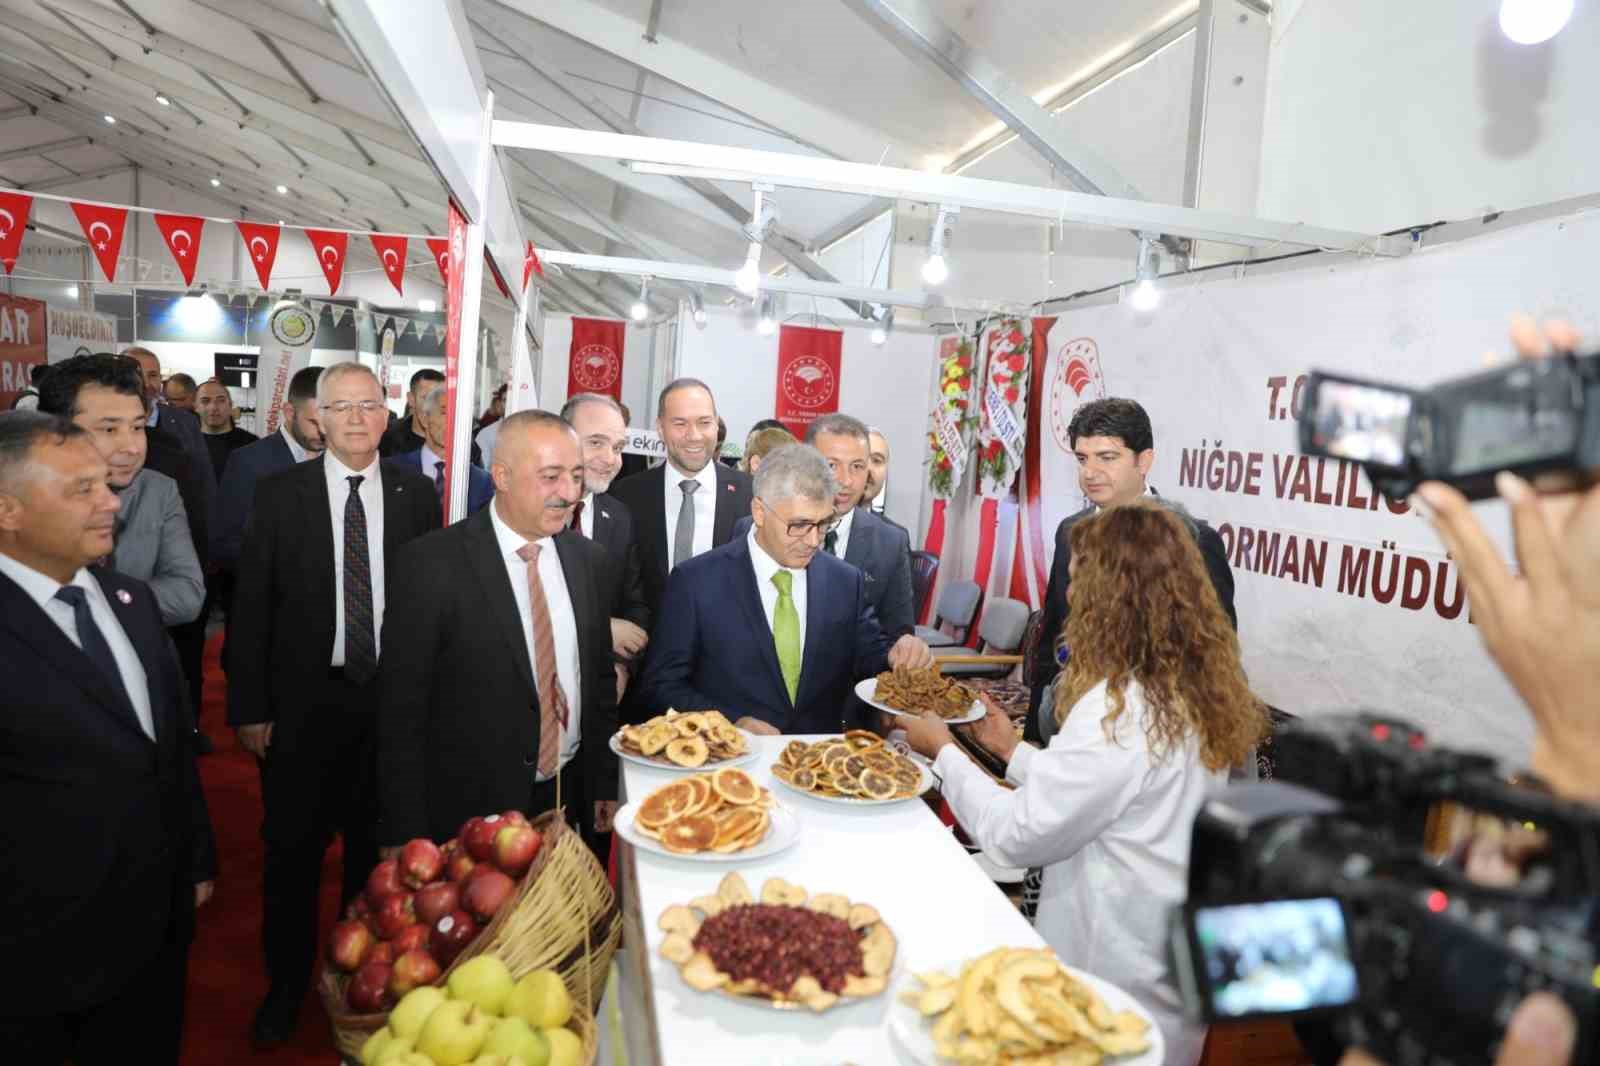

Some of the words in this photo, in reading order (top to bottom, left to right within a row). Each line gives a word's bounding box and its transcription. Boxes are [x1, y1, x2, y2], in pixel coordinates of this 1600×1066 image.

[1179, 438, 1263, 496] NİĞDE
[1217, 522, 1328, 588] ORMAN
[1337, 540, 1475, 624] MÜDÜ
